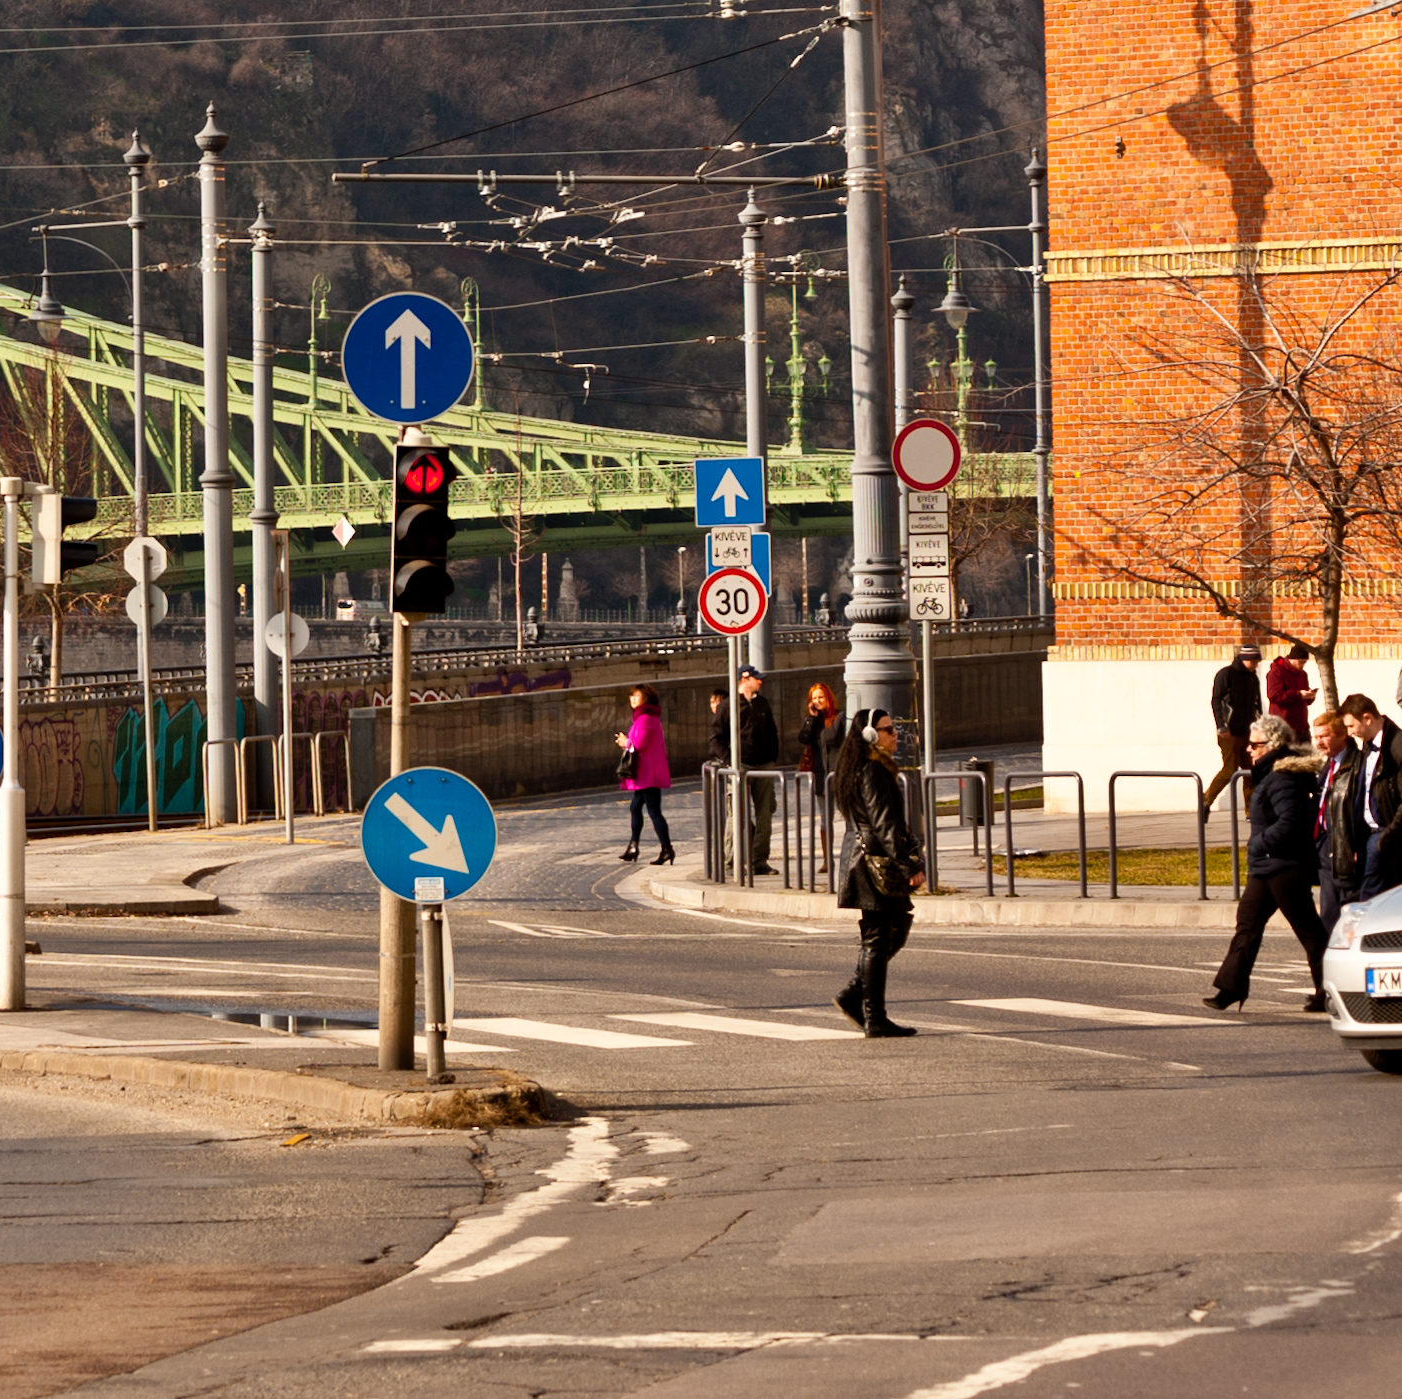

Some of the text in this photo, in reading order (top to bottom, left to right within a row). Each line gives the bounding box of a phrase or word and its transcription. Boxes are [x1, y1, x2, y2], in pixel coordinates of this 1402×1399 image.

[715, 529, 748, 541] KIVÉVE
[915, 539, 941, 548] KIVÉVE
[912, 581, 946, 593] KIVÉVE
[715, 588, 750, 616] 30
[1378, 971, 1402, 990] KM
